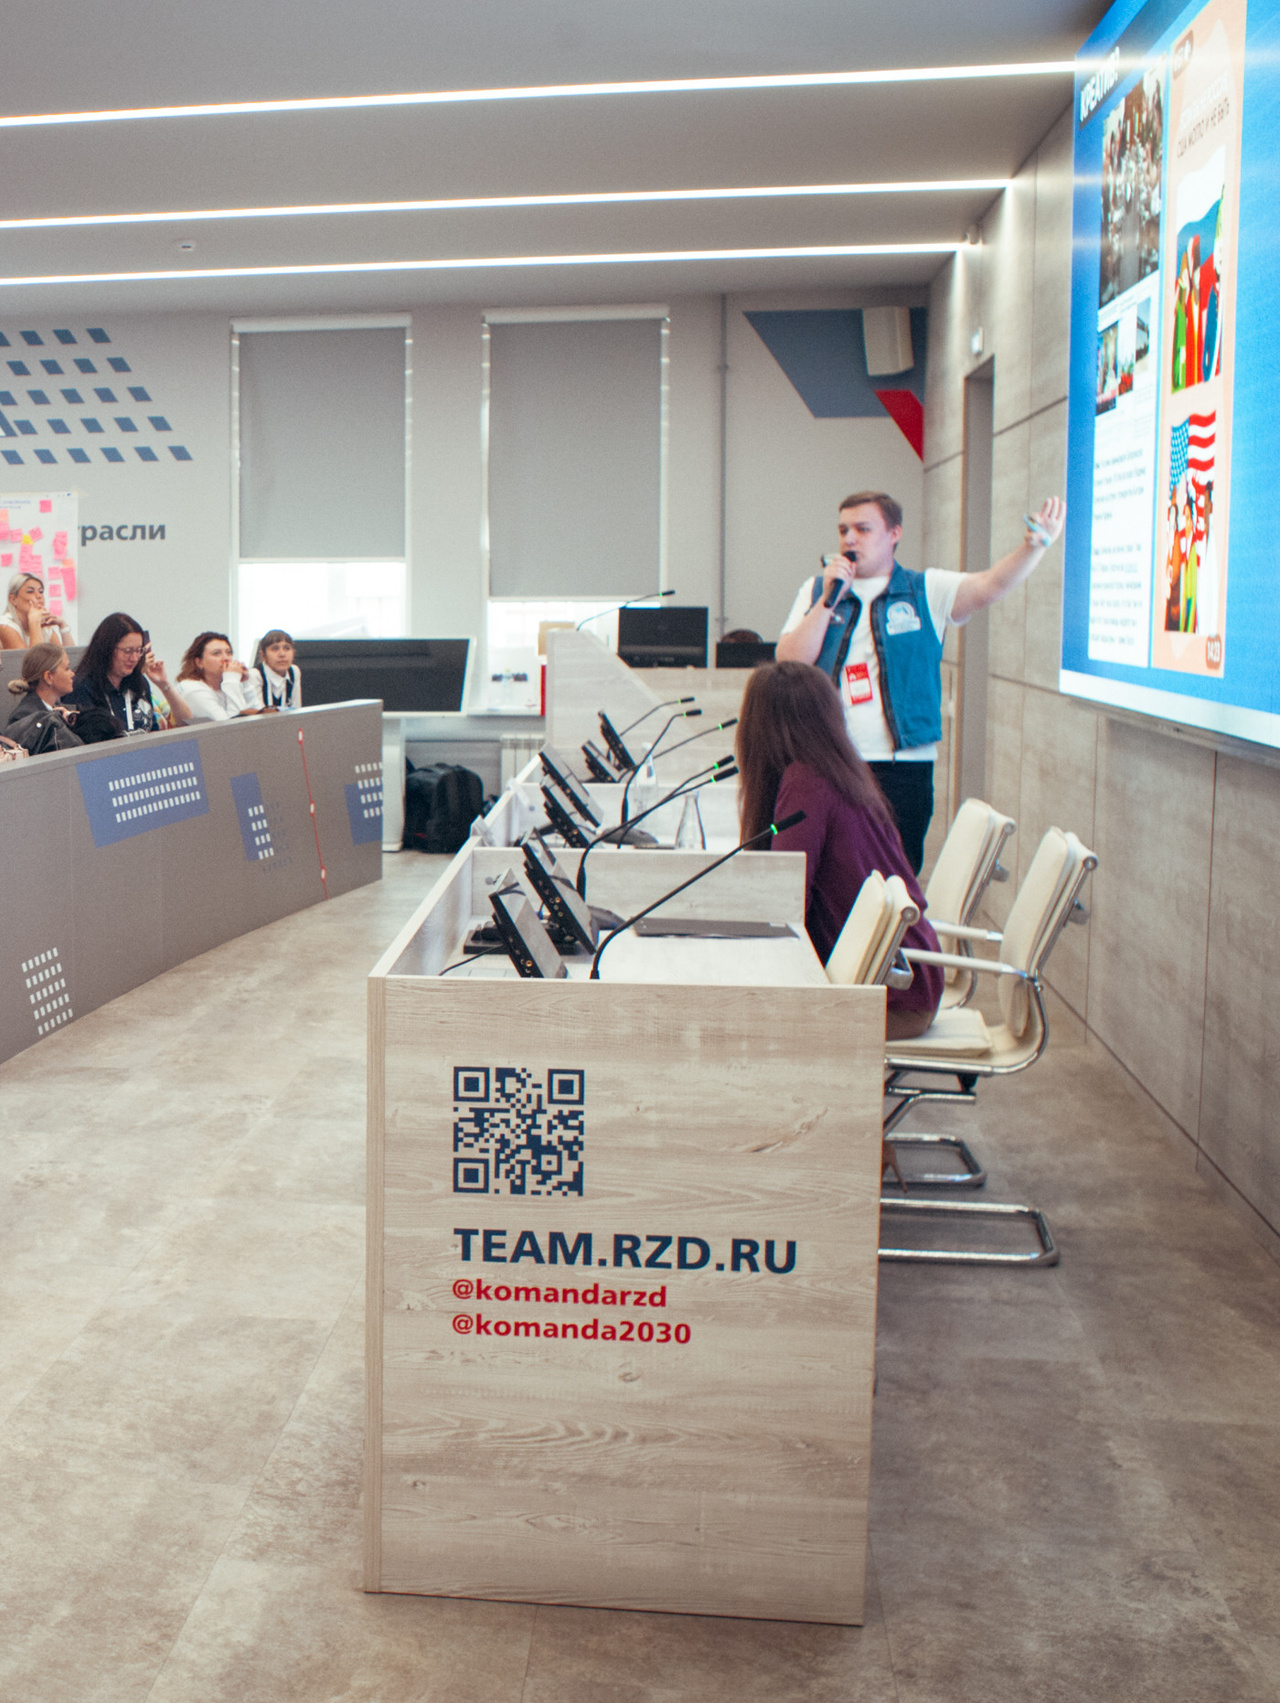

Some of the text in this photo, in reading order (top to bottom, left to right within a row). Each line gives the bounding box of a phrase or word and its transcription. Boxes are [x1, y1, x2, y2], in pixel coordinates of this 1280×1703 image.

[78, 524, 166, 547] расли
[453, 1228, 797, 1274] TEAM.RZD.RU
[452, 1278, 667, 1308] @komandarzd
[452, 1313, 691, 1344] @komanda2030
